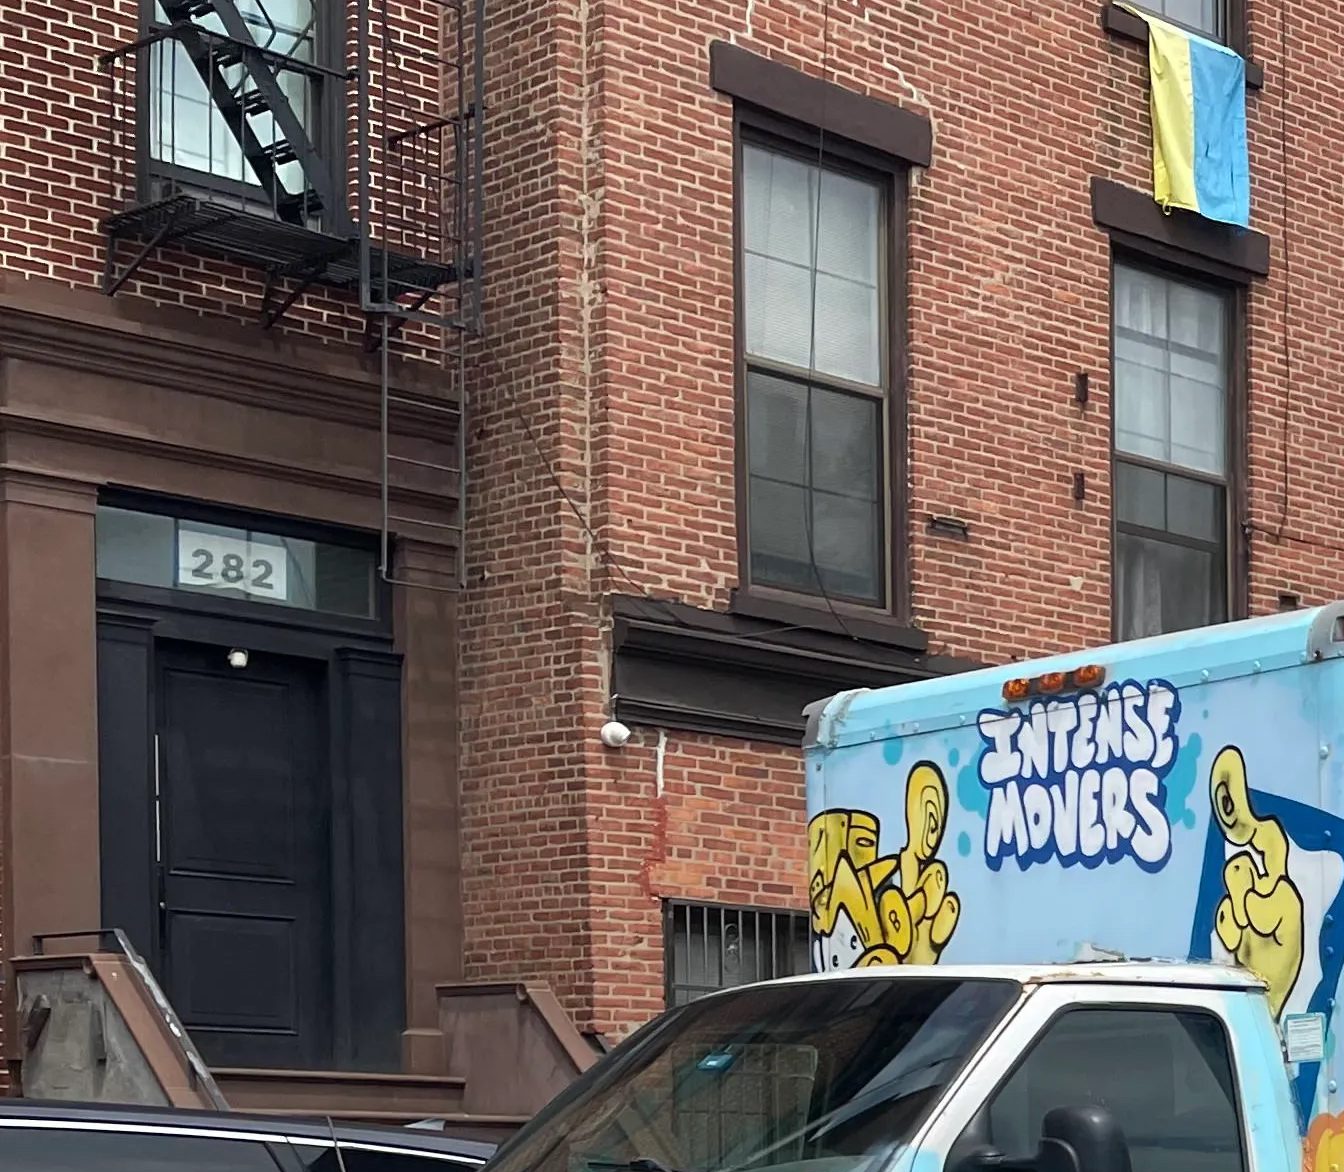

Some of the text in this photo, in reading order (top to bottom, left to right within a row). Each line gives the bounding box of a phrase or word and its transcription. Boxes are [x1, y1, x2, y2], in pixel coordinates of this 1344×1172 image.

[191, 548, 274, 590] 282
[978, 682, 1176, 785] INTENSE
[985, 766, 1171, 864] MOVERS
